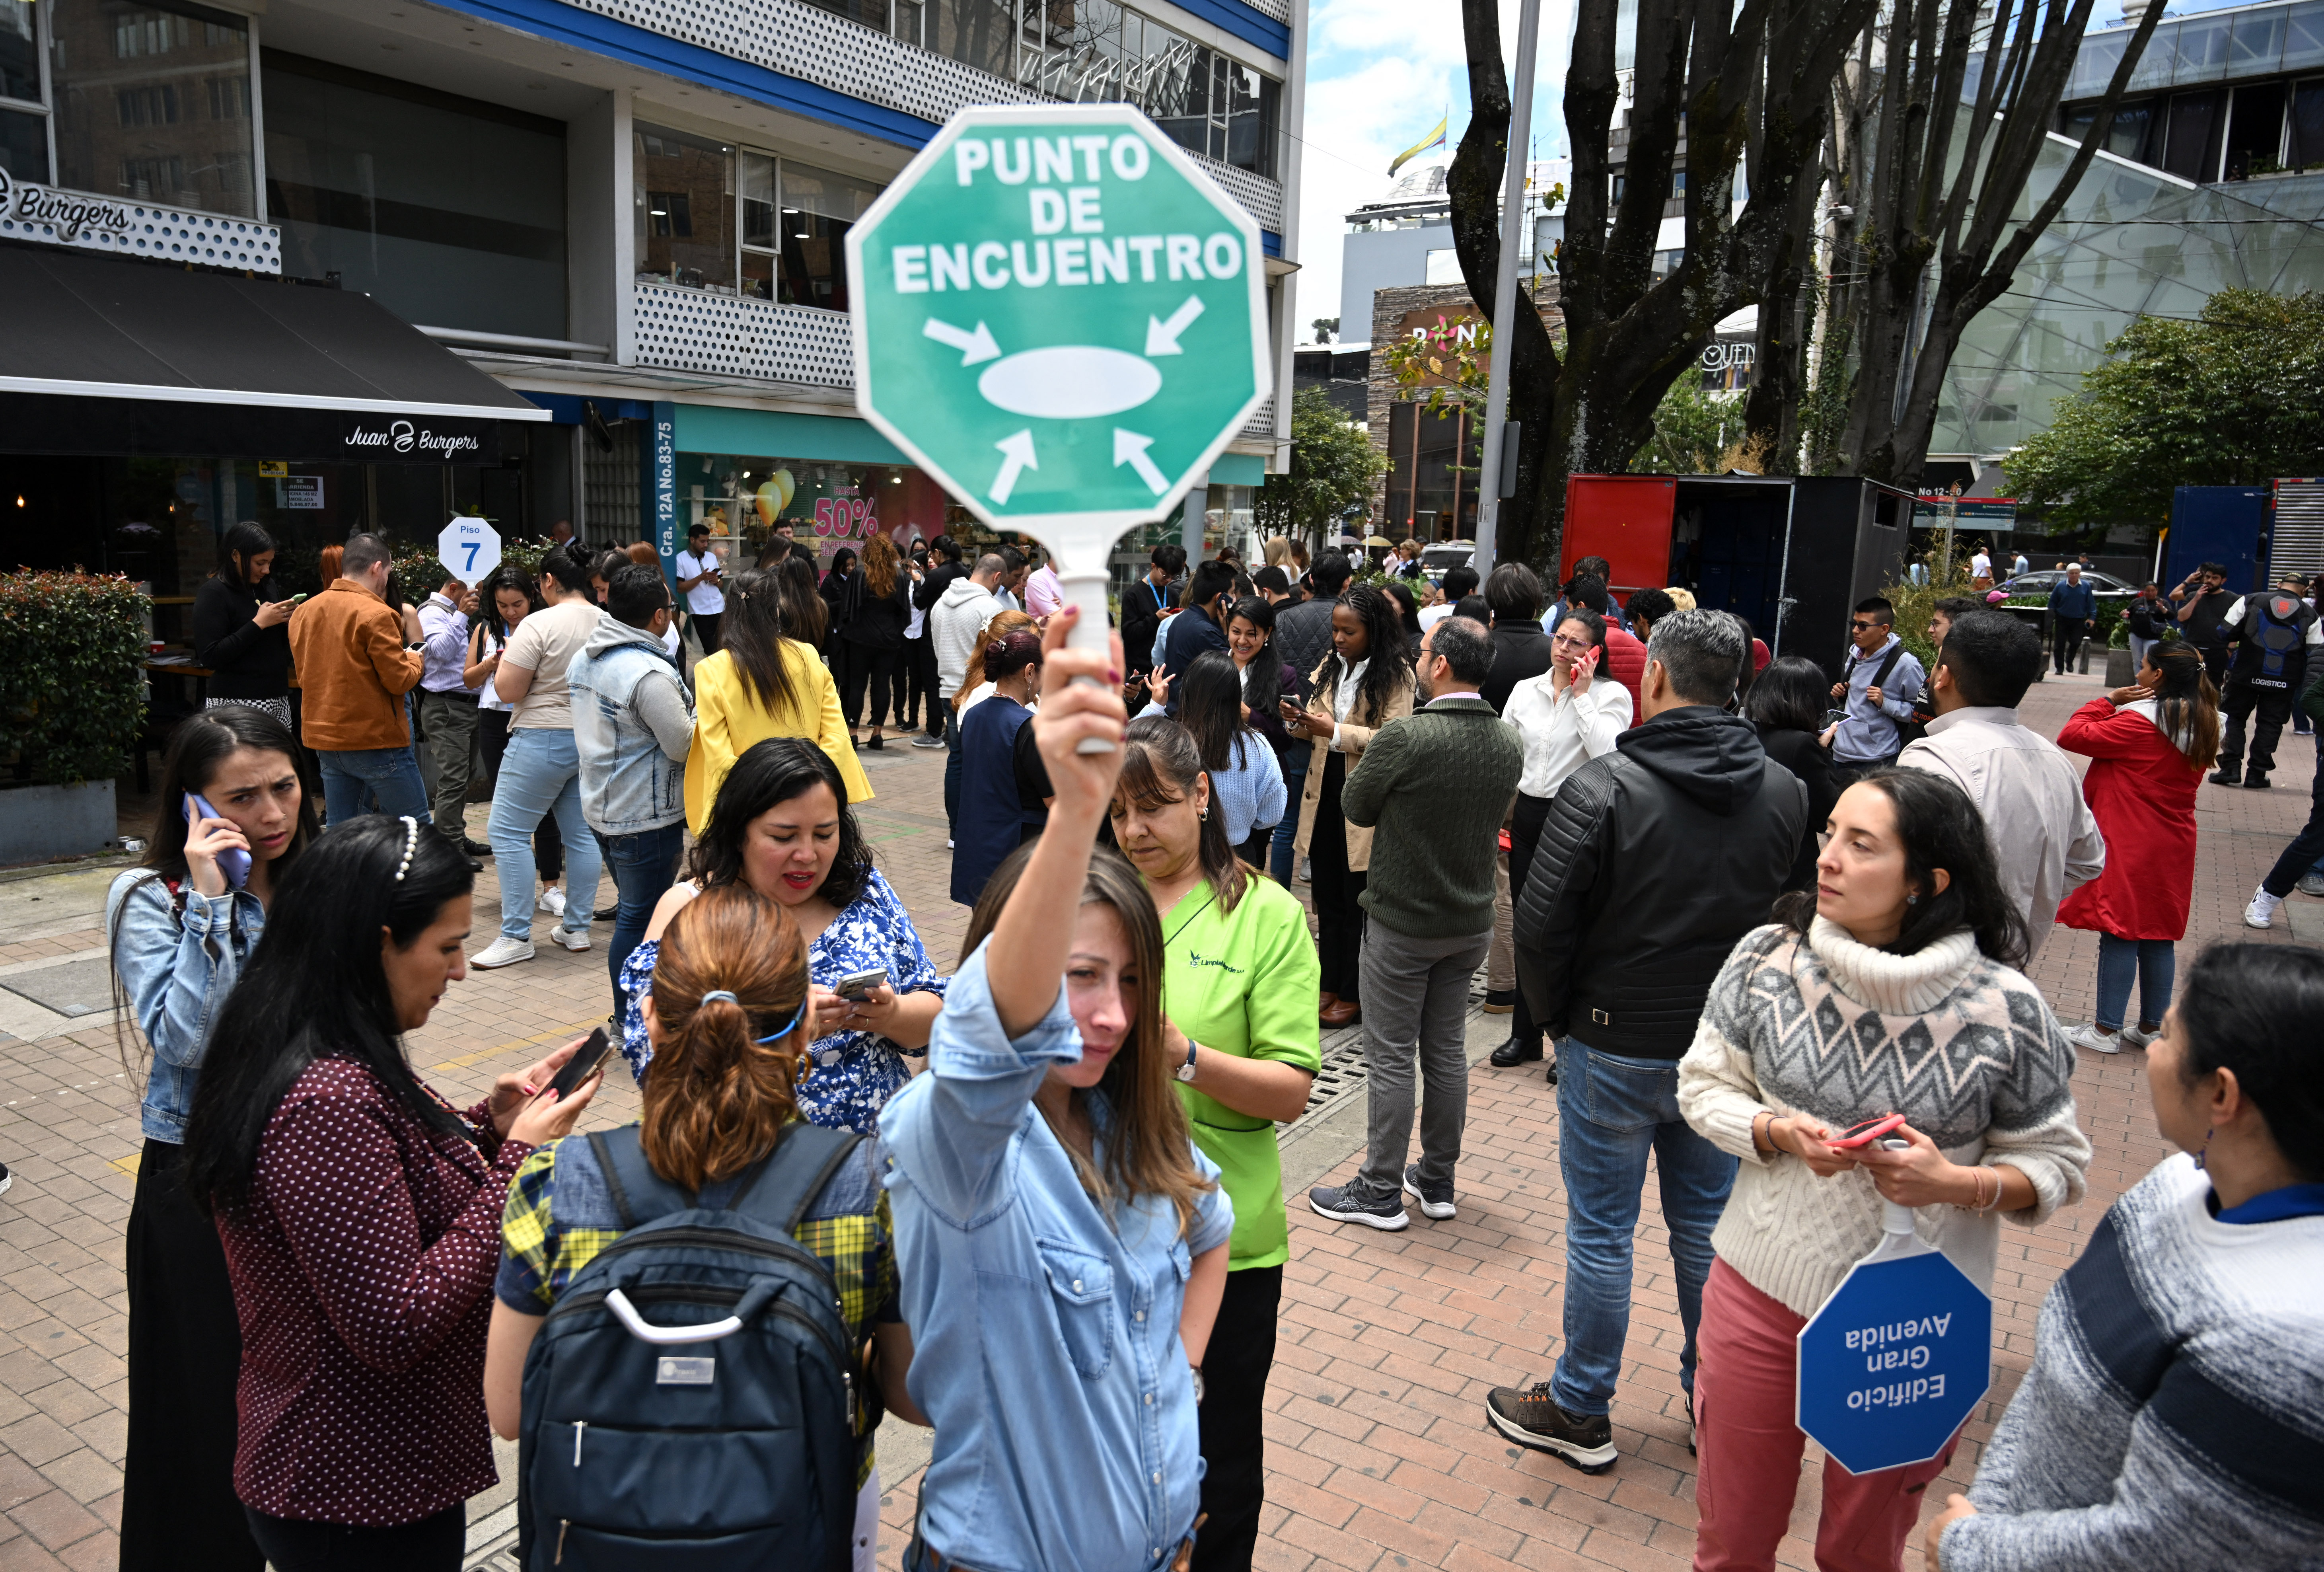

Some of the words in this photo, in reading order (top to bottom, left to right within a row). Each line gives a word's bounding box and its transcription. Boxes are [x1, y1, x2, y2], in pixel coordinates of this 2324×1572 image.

[955, 134, 1150, 187] PUNTO
[19, 188, 129, 236] Burgers
[1029, 187, 1104, 236] DE
[892, 232, 1243, 294] ENCUENTRO
[345, 425, 389, 446] Juan
[419, 430, 479, 458] Burgers
[658, 422, 672, 489] No.83-75
[659, 492, 673, 521] 12A
[834, 485, 860, 496] HASTA
[1918, 487, 1932, 496] No
[814, 497, 878, 539] 50%
[461, 542, 481, 572] 7
[660, 526, 673, 557] Cra.
[2251, 677, 2287, 688] LOGISTICO
[1201, 959, 1236, 973] LimpiaVerde
[1845, 1312, 1952, 1352] Avenida
[1867, 1345, 1930, 1373] Gran
[1846, 1374, 1945, 1412] Edificio
